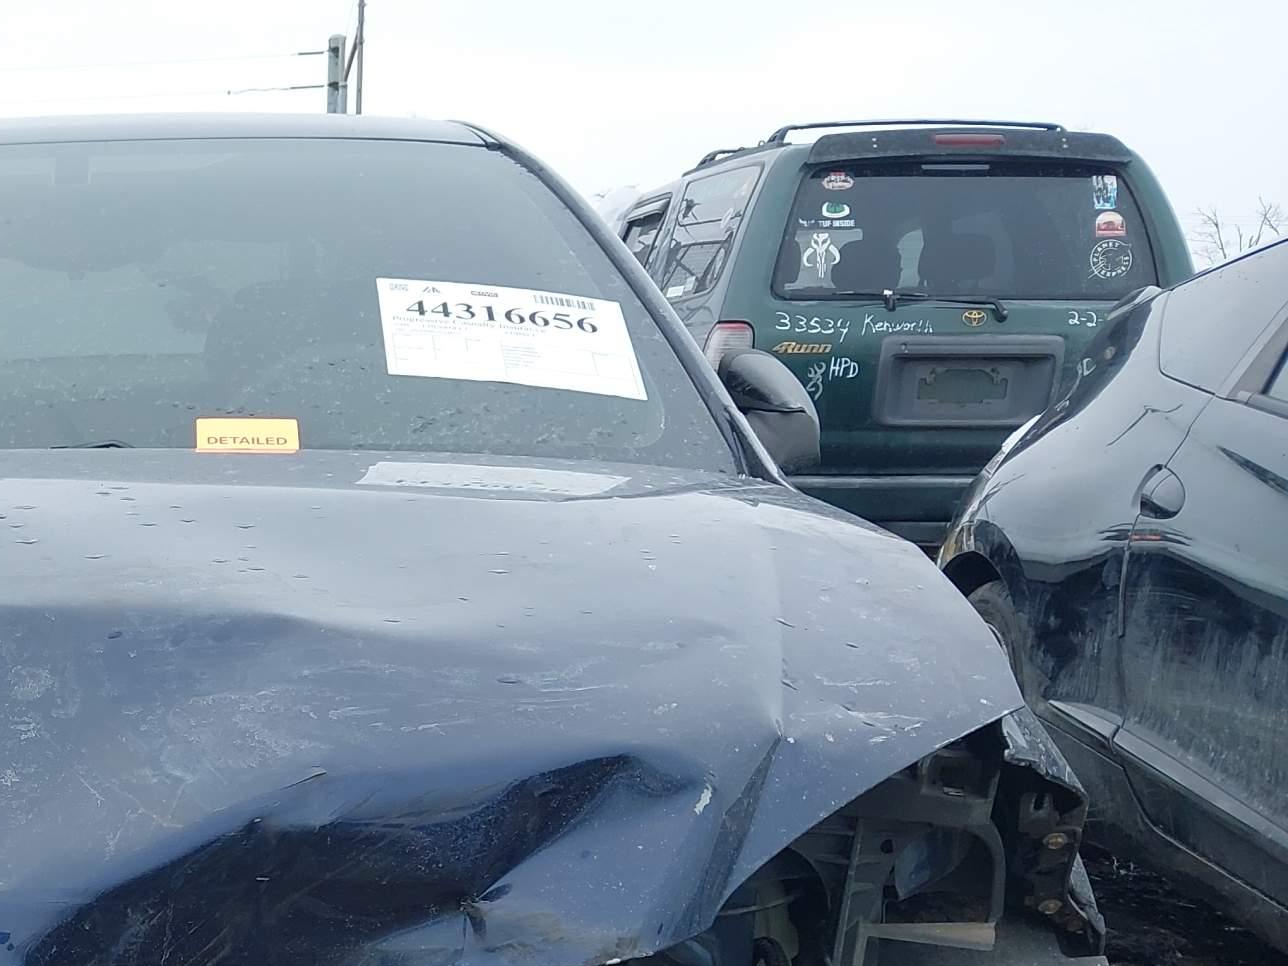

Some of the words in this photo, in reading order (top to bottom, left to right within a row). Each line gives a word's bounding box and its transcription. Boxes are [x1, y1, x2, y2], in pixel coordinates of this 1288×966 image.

[1093, 241, 1121, 262] PLANET
[405, 299, 599, 334] 44316656
[775, 311, 851, 343] 33534
[828, 356, 859, 381] HPD
[206, 436, 288, 446] DETAILED
